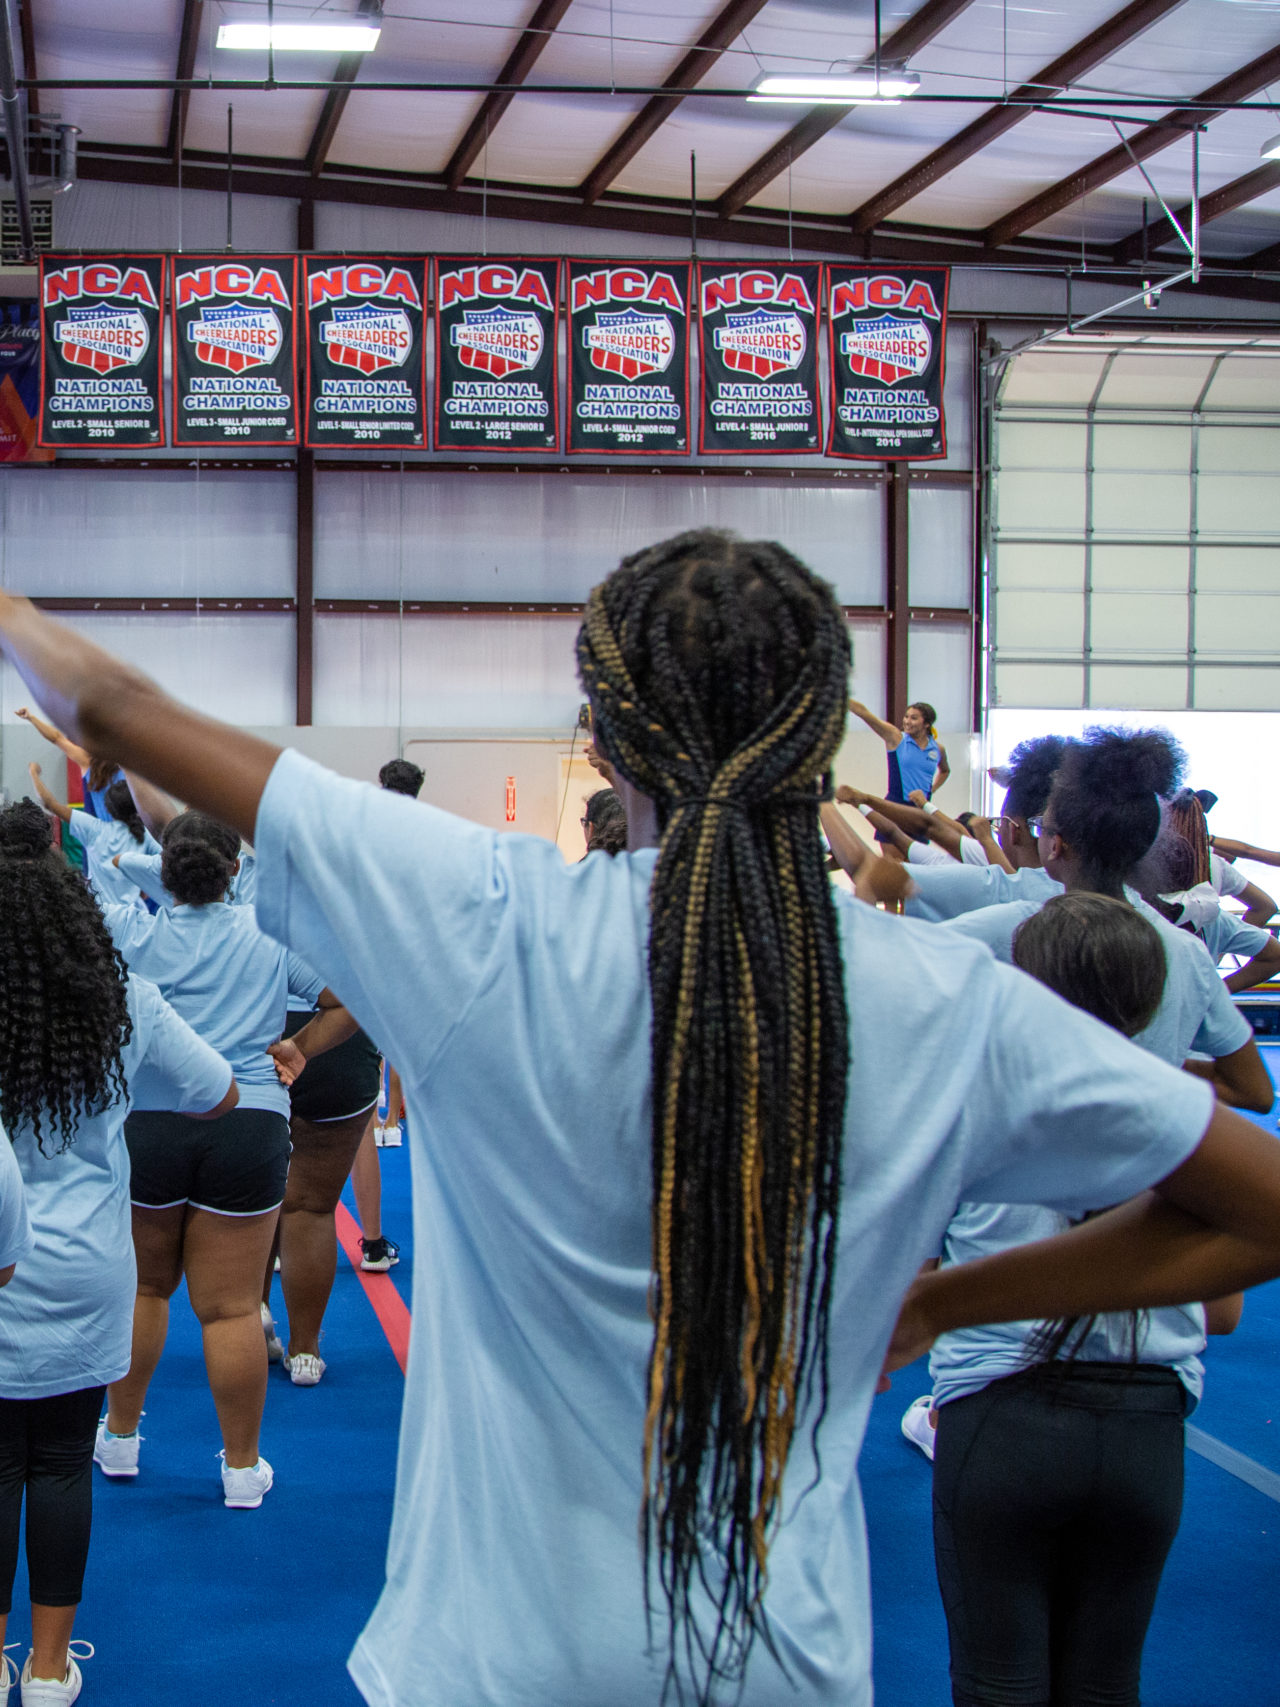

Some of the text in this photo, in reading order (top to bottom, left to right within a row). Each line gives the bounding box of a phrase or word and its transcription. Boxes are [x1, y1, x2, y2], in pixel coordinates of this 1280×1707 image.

[44, 264, 159, 310] NCA
[176, 264, 292, 310] NCA
[308, 264, 422, 311] NCA
[439, 264, 554, 312] NCA
[572, 268, 685, 316] NCA
[702, 270, 815, 317] NCA
[831, 275, 941, 321] NCA
[76, 317, 132, 329] NATIONAL
[210, 317, 265, 329] NATIONAL
[341, 317, 397, 329] NATIONAL
[473, 321, 528, 333] NATIONAL
[605, 323, 659, 335] NATIONAL
[735, 322, 789, 334] NATIONAL
[62, 328, 143, 347] CHEERLEADERS
[195, 328, 277, 347] CHEERLEADERS
[327, 329, 408, 348] CHEERLEADERS
[458, 332, 539, 351] CHEERLEADERS
[863, 328, 915, 339] NATIONAL
[70, 337, 131, 357] ASSOCIATION
[204, 337, 265, 358] ASSOCIATION
[336, 338, 396, 358] ASSOCIATION
[467, 341, 527, 361] ASSOCIATION
[591, 334, 670, 353] CHEERLEADERS
[721, 334, 801, 351] CHEERLEADERS
[848, 340, 927, 357] CHEERLEADERS
[600, 343, 659, 363] ASSOCIATION
[731, 343, 790, 361] ASSOCIATION
[858, 349, 916, 368] ASSOCIATION
[55, 378, 147, 394] NATIONAL
[190, 377, 281, 393] NATIONAL
[322, 379, 412, 396] NATIONAL
[453, 382, 542, 399] NATIONAL
[585, 385, 674, 401] NATIONAL
[718, 383, 807, 398] NATIONAL
[49, 396, 153, 412] CHAMPIONS
[184, 395, 290, 410] CHAMPIONS
[314, 396, 417, 413] CHAMPIONS
[844, 388, 929, 406] NATIONAL
[444, 399, 548, 416] CHAMPIONS
[577, 402, 680, 419] CHAMPIONS
[711, 400, 812, 416] CHAMPIONS
[838, 405, 939, 423] CHAMPIONS
[52, 420, 76, 428] LEVEL
[76, 420, 83, 428] 2
[86, 420, 113, 428] SMALL
[114, 420, 143, 428] SENIOR
[187, 417, 287, 426] LEVEL 3 SMALL JUNIOR COED
[450, 421, 475, 429] LEVEL
[475, 421, 480, 430] 2
[485, 422, 510, 430] LARGE
[511, 422, 538, 431] SENIOR
[715, 422, 740, 431] LEVEL
[740, 422, 745, 431] 4
[750, 423, 775, 431] SMALL
[776, 423, 804, 431] JUNIOR
[88, 429, 115, 437] 2010
[224, 426, 250, 435] 2010
[354, 430, 380, 439] 2010
[486, 431, 511, 440] 2012
[617, 433, 644, 442] 2012
[750, 432, 776, 440] 2016
[876, 438, 901, 447] 2016
